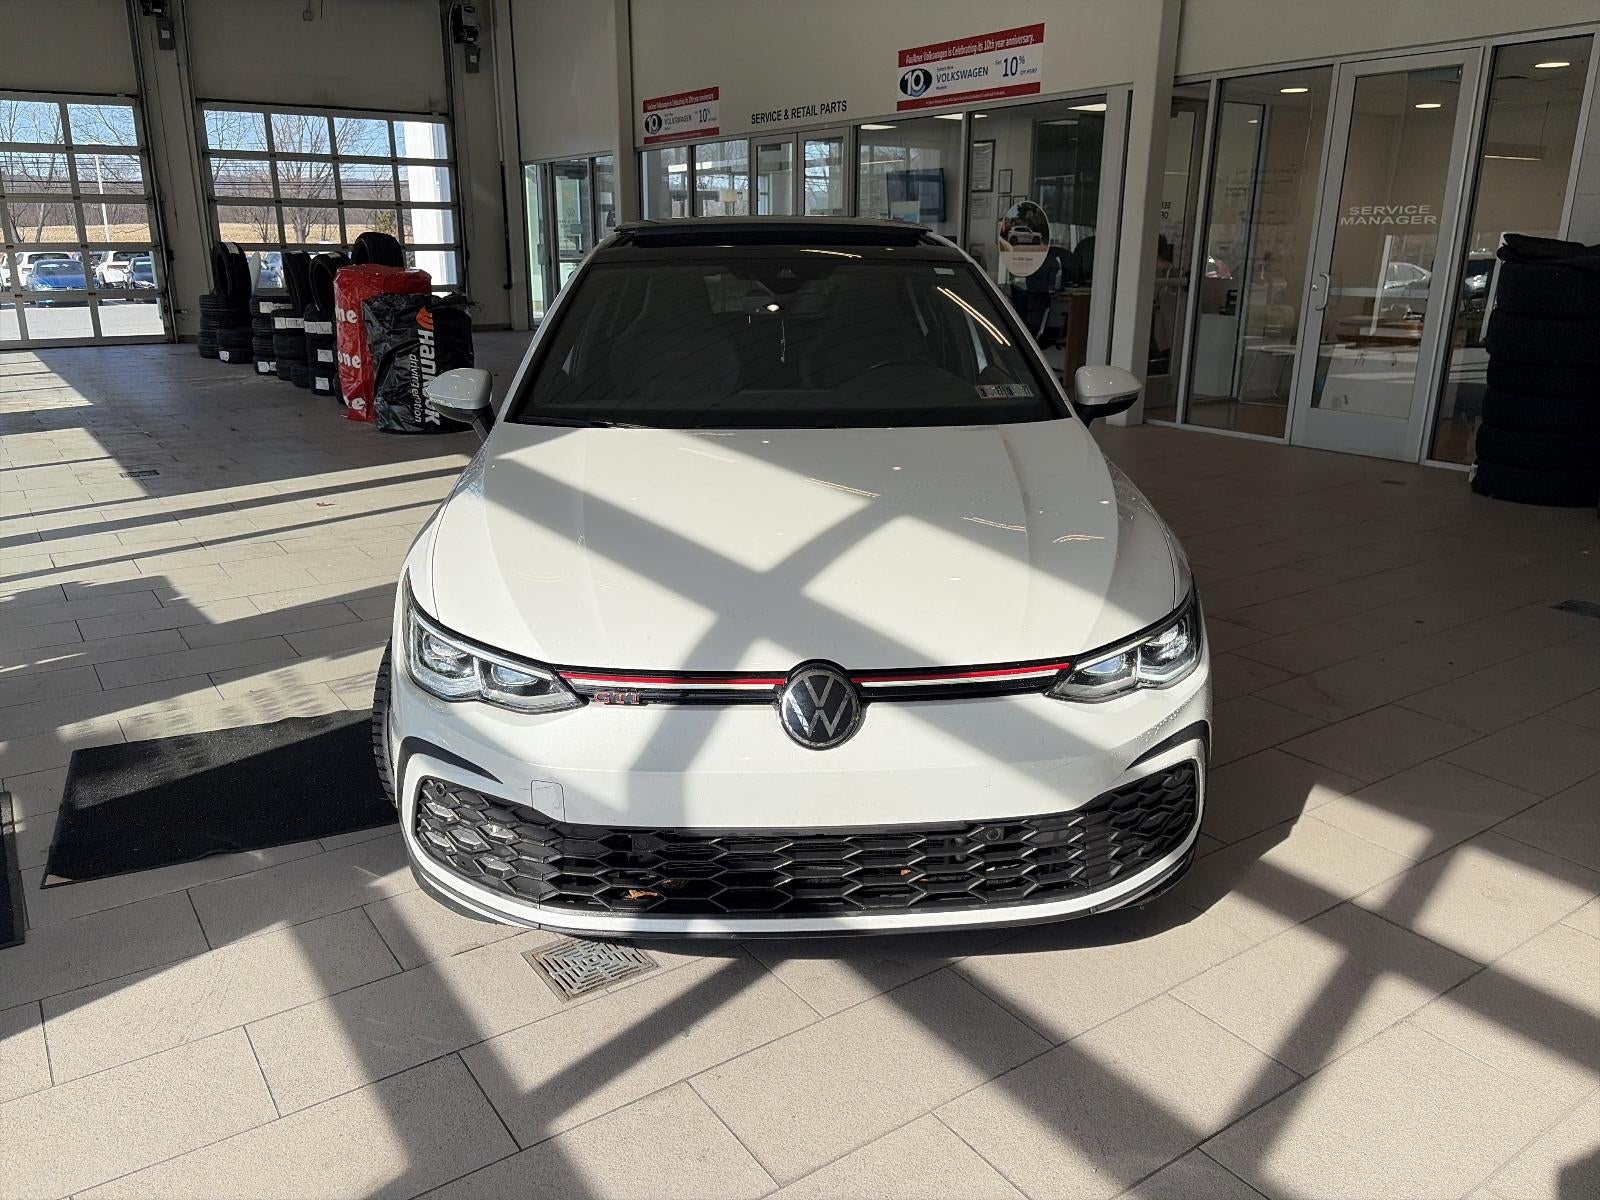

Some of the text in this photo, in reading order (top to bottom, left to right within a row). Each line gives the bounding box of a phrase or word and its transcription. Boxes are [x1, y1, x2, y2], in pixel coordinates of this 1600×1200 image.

[936, 66, 989, 83] VOLKSWAGEN
[751, 100, 847, 124] SERVICE & RETAIL PARTS
[1349, 205, 1432, 215] SERVICE
[1340, 215, 1437, 225] MANAGER
[409, 353, 420, 388] driving
[593, 691, 640, 705] GTI
